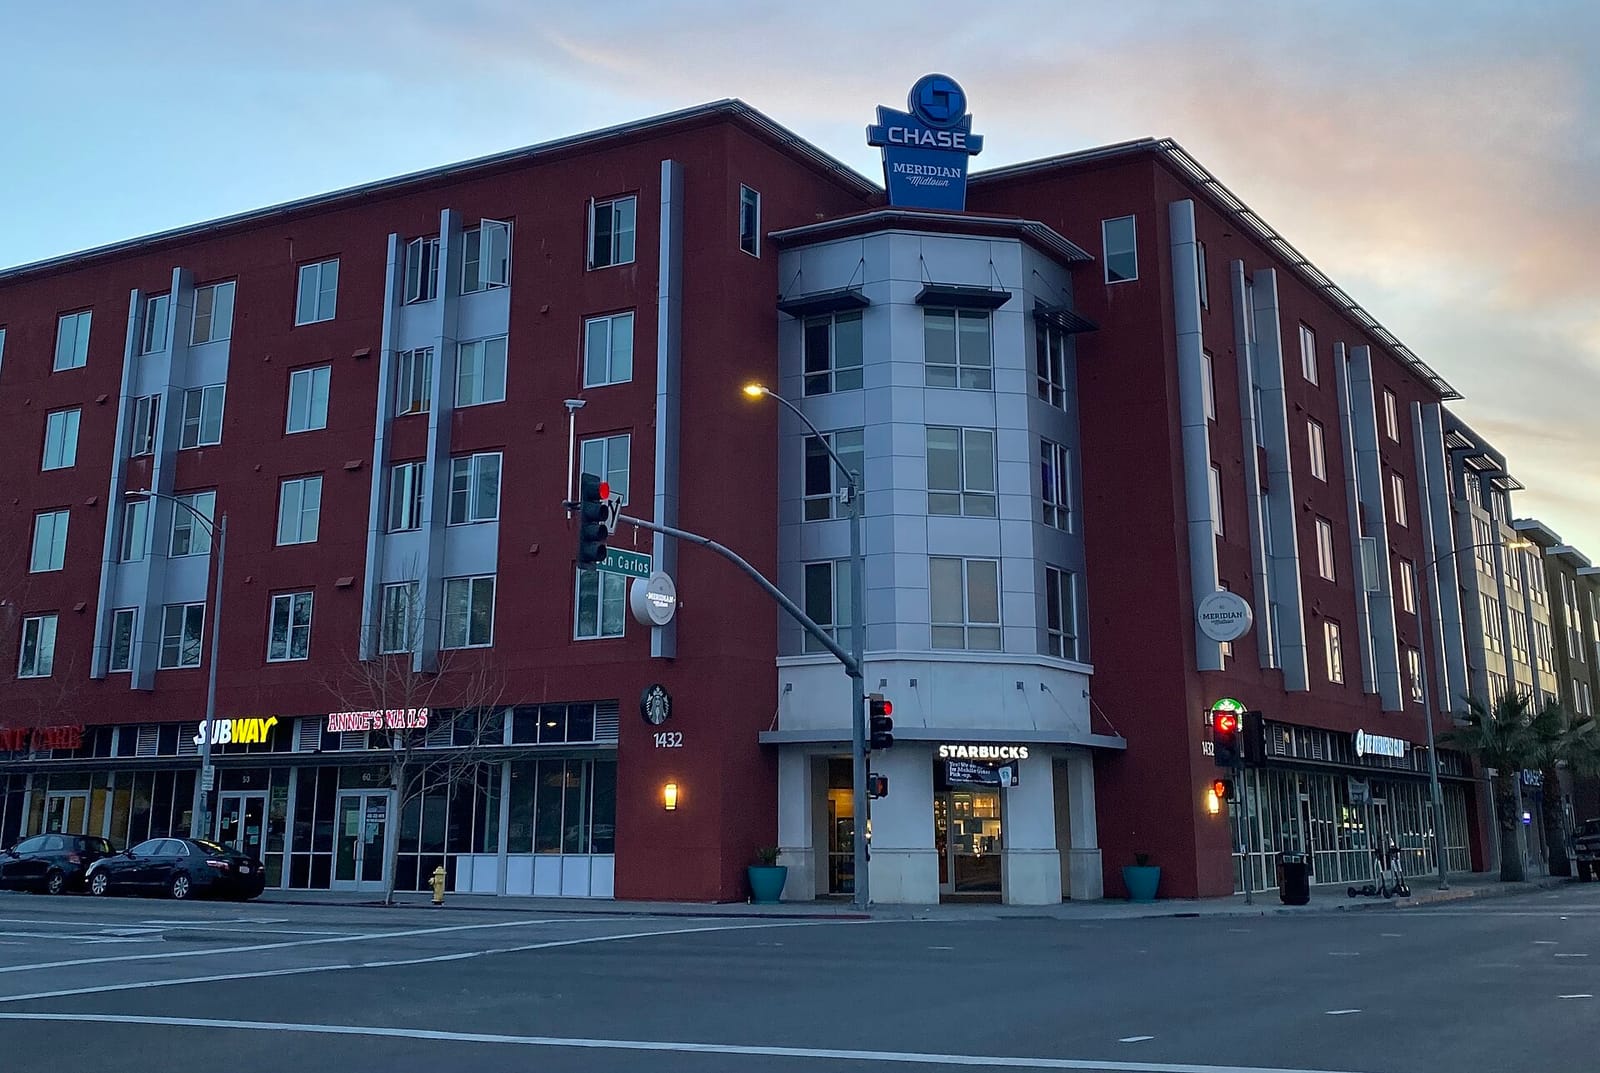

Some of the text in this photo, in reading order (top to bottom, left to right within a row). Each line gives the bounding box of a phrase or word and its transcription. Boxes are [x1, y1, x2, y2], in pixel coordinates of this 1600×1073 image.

[888, 126, 967, 149] CHASE
[893, 162, 962, 178] MERIDIAN
[906, 175, 950, 187] Midtown
[617, 555, 649, 574] Carlos
[1203, 612, 1242, 620] MERIDIAN
[328, 710, 383, 732] ANNIE'S
[192, 716, 279, 746] SUBWAY
[653, 731, 683, 748] 1432
[939, 745, 1029, 759] STARBUCKS
[1201, 740, 1215, 756] 1432
